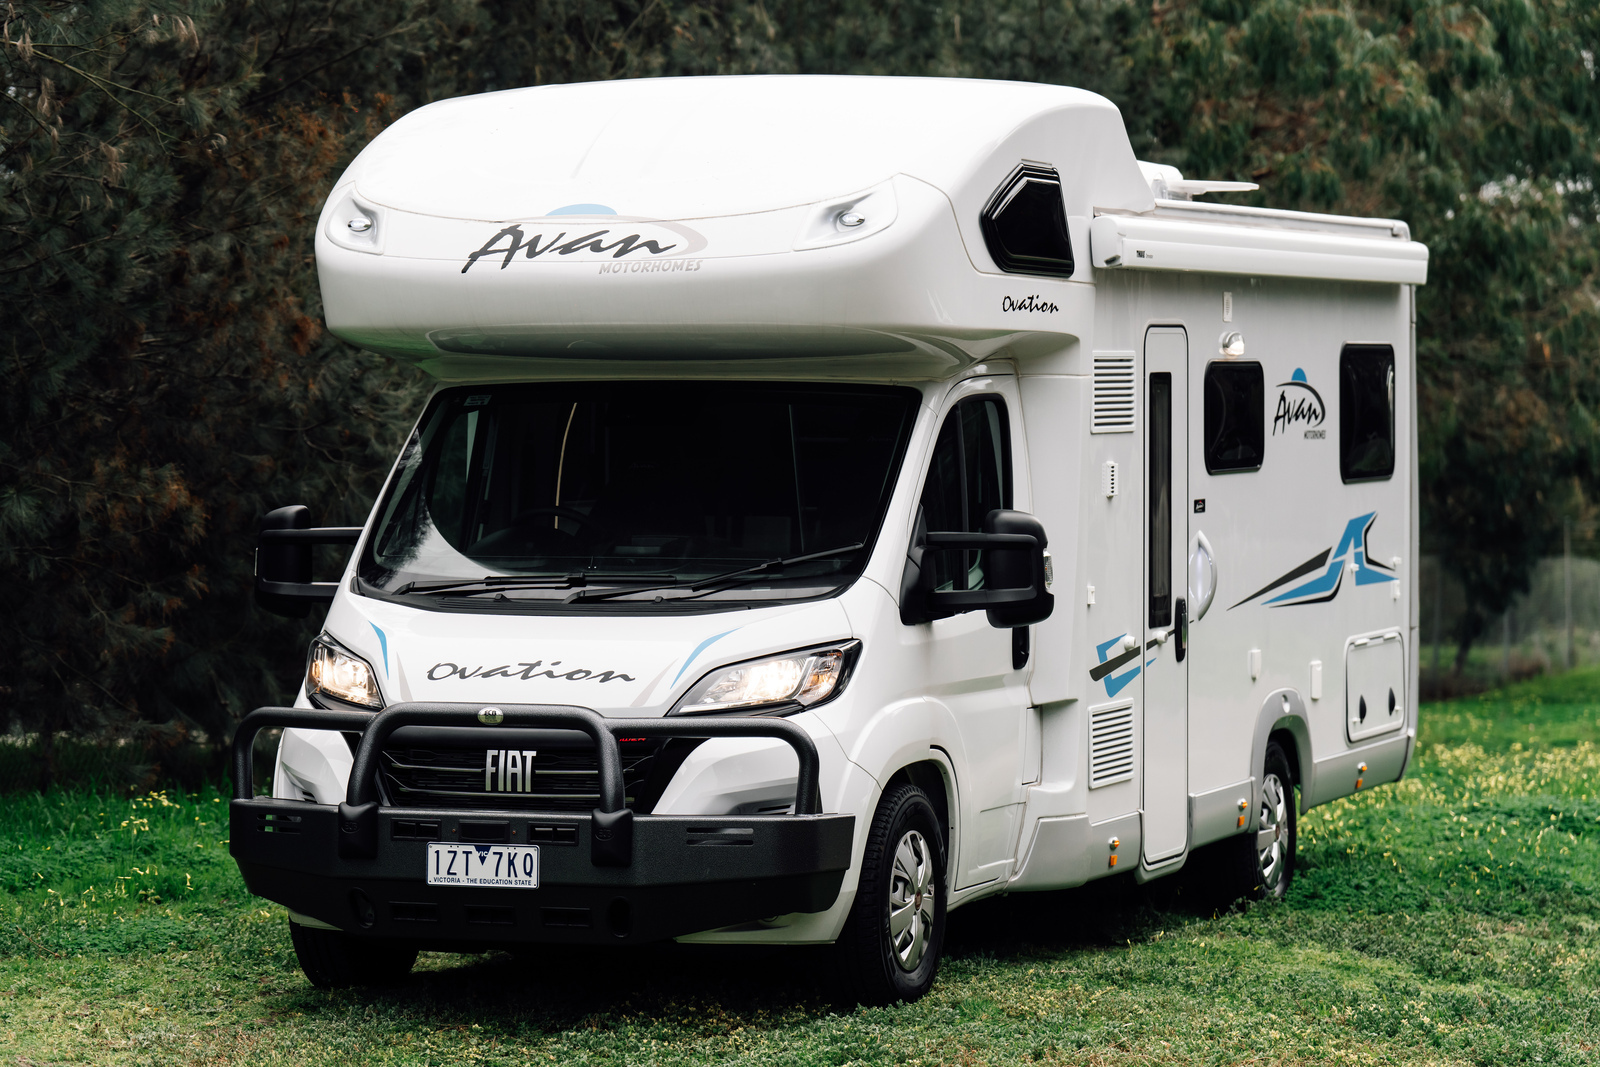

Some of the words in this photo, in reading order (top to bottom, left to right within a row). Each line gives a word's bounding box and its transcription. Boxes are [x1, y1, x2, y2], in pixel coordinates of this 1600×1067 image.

[461, 223, 677, 274] Avan
[598, 260, 703, 274] MOTORHOMES
[1002, 294, 1059, 314] Ovation
[1272, 389, 1321, 437] Avan
[426, 660, 636, 683] Ovation
[485, 750, 537, 793] FIAT
[434, 849, 473, 876] 1ZT
[492, 851, 533, 878] 7KQ
